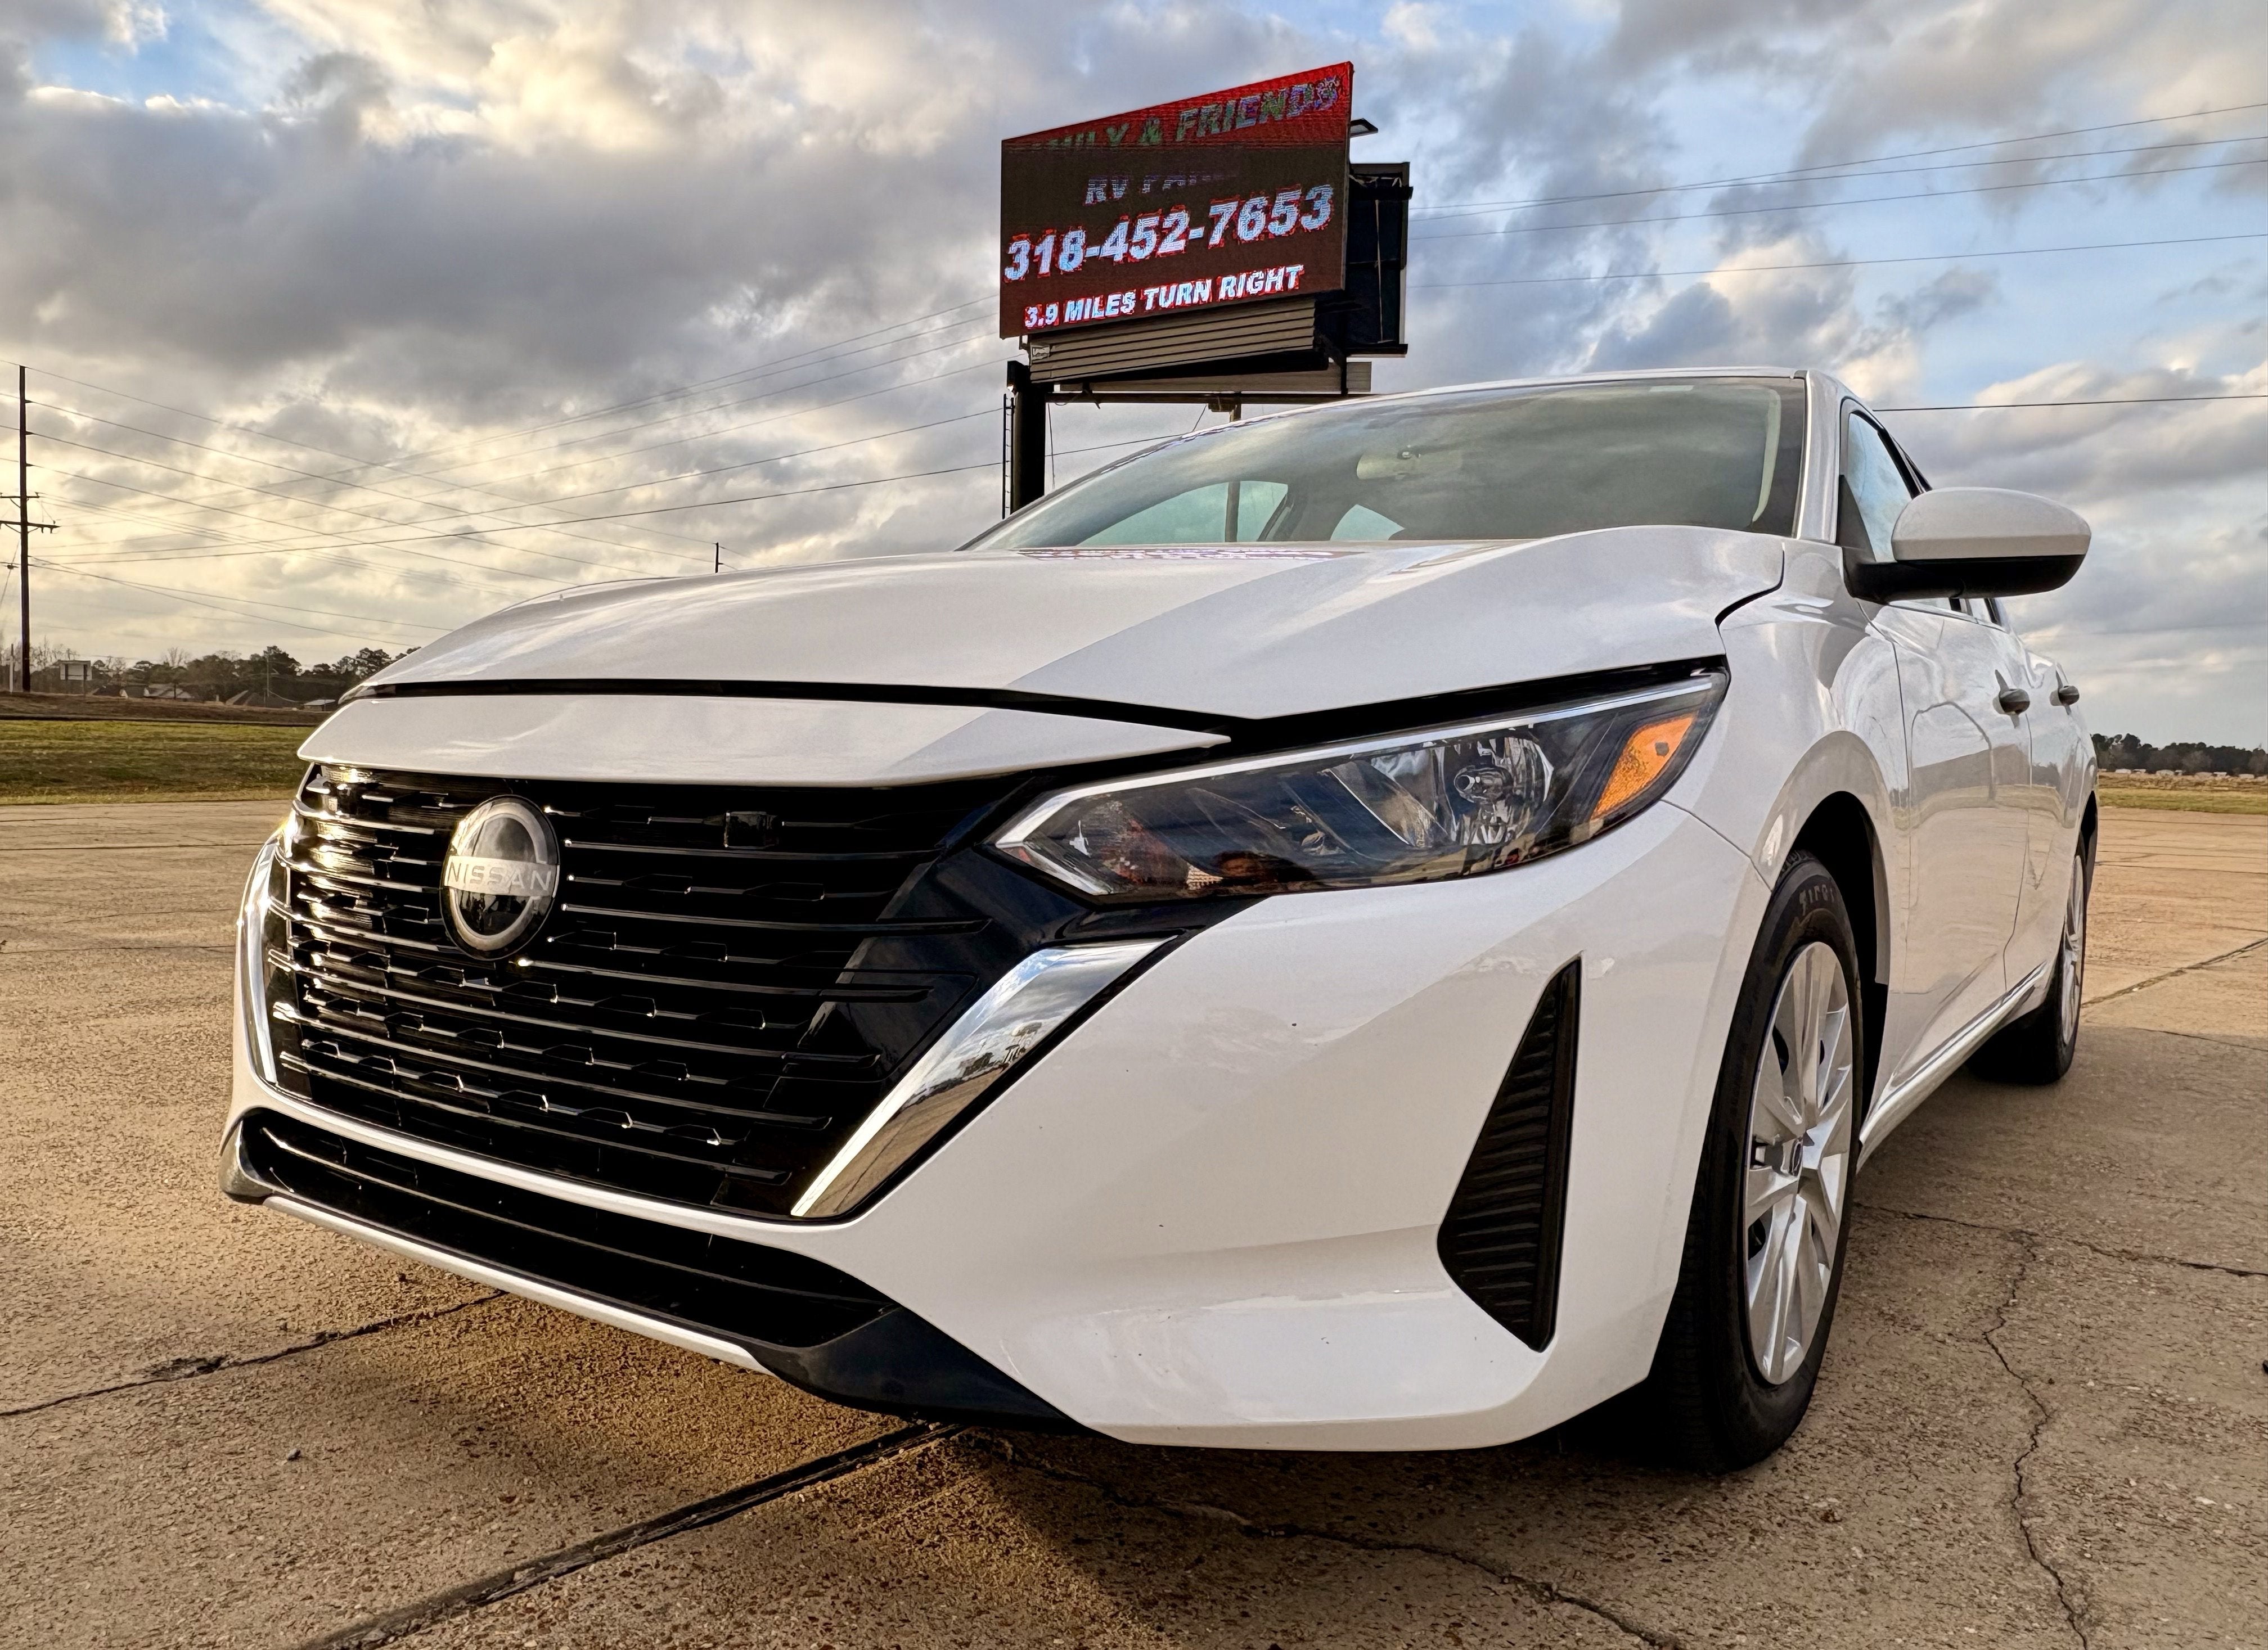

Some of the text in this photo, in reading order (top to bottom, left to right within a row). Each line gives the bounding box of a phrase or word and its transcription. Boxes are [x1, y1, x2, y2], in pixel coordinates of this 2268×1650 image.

[1138, 116, 1162, 146] &
[1175, 75, 1340, 142] FRIENDS
[1084, 175, 1129, 205] RV
[1004, 184, 1334, 281] 318-452-7653
[1024, 264, 1304, 328] 3.9 MILES TURN RIGHT
[447, 860, 552, 892] NISSAN
